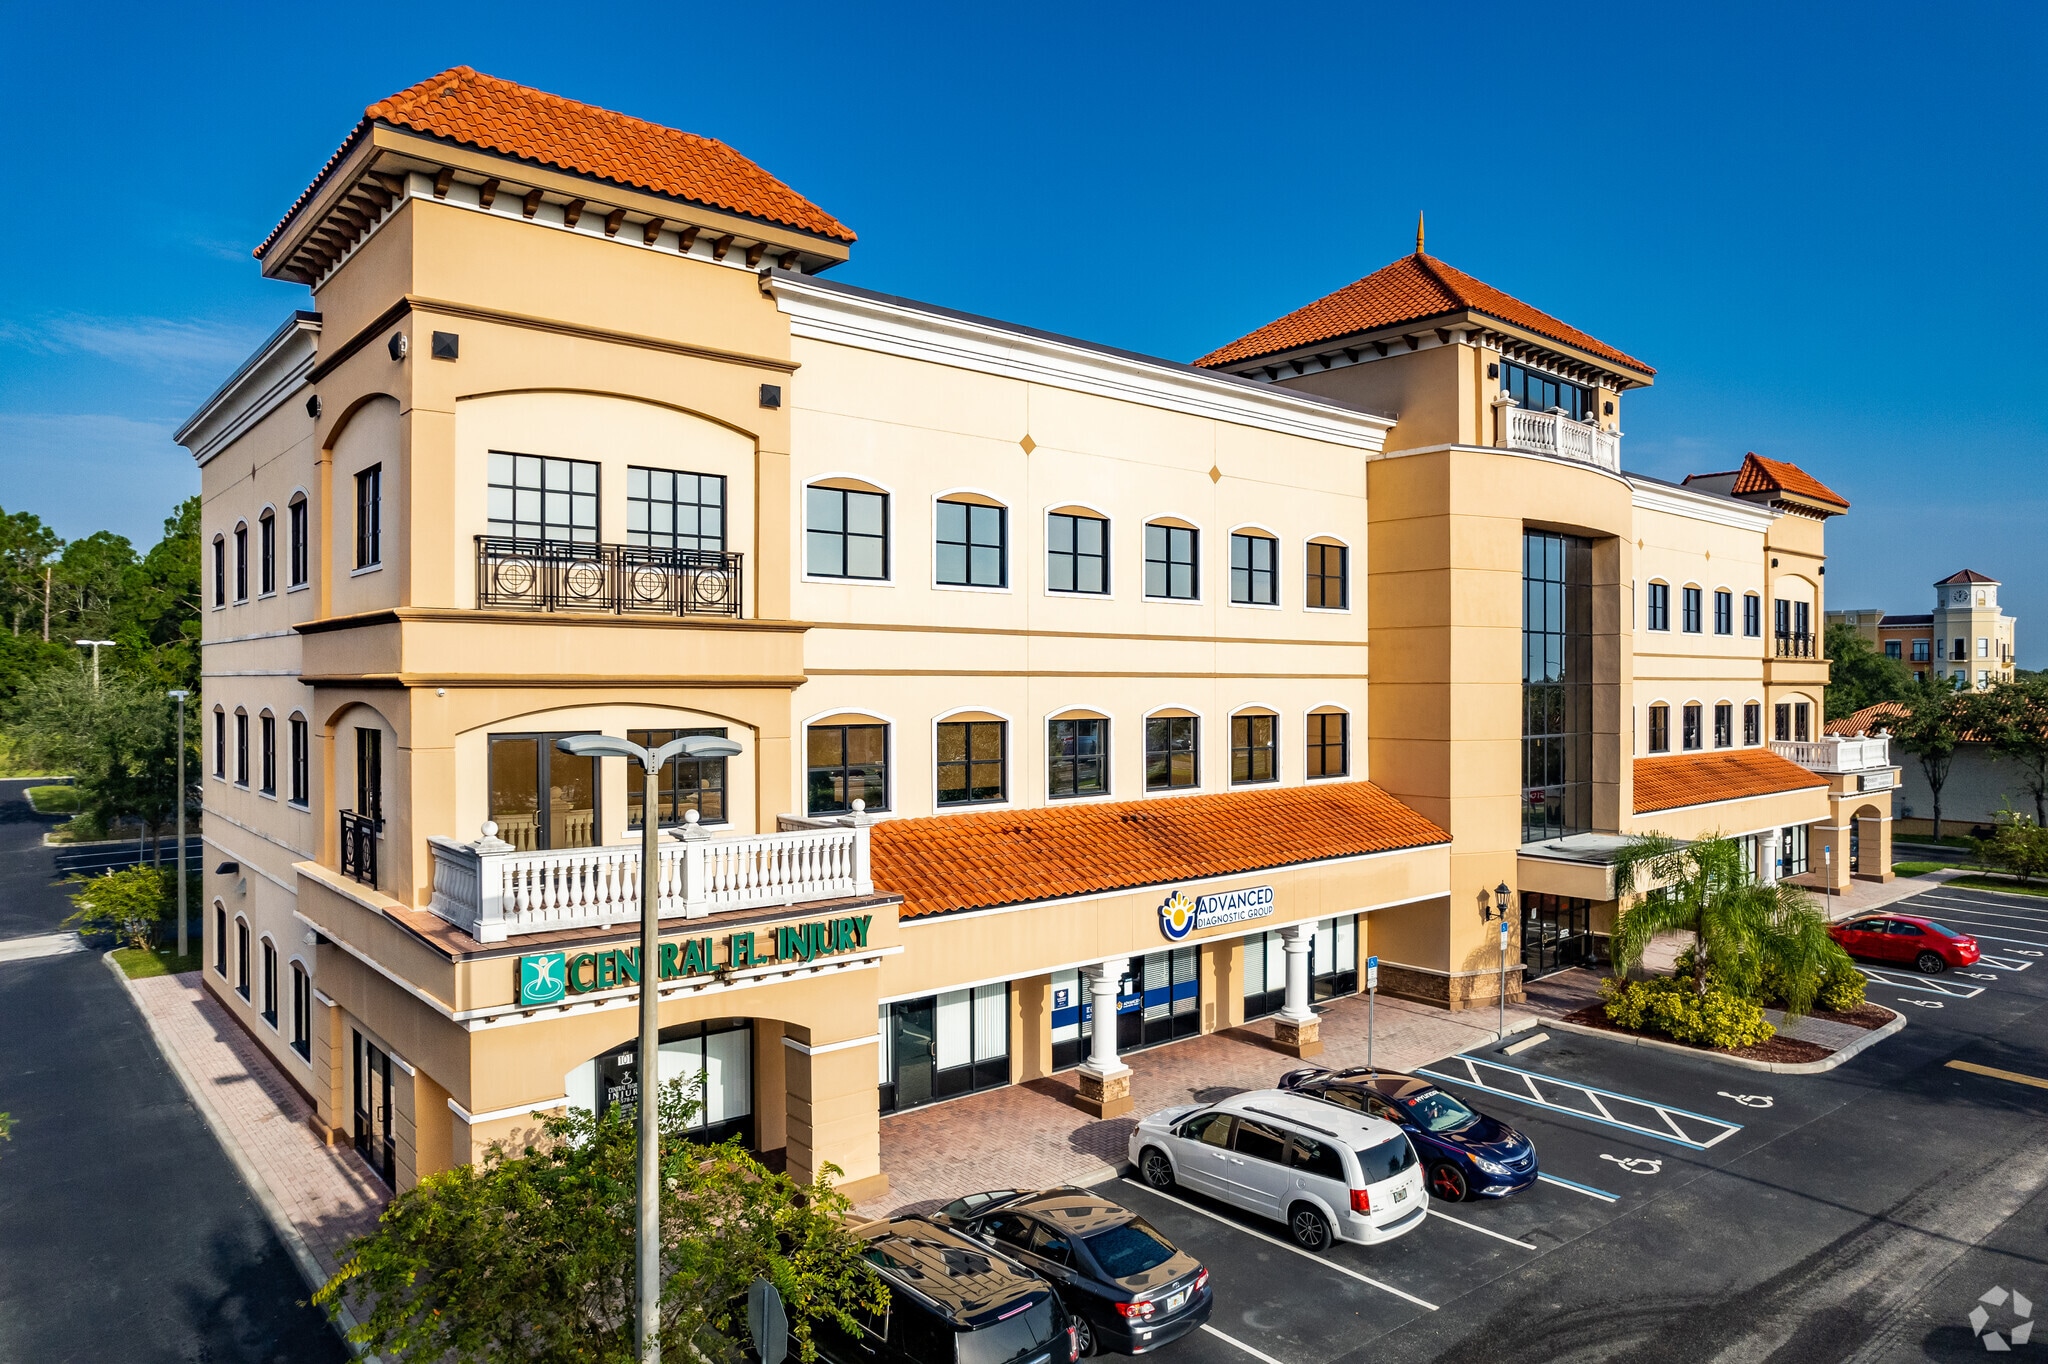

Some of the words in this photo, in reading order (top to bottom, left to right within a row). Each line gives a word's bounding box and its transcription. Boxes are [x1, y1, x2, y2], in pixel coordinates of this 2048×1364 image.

[1198, 888, 1273, 915] ADVANCED
[1198, 911, 1246, 927] DIAGNOSTIC
[1248, 905, 1273, 918] GROUP
[568, 937, 721, 993] CENRAL
[729, 931, 768, 968] FL.
[776, 915, 872, 963] INJURY
[619, 1054, 632, 1065] 101
[608, 1089, 638, 1100] INJUR
